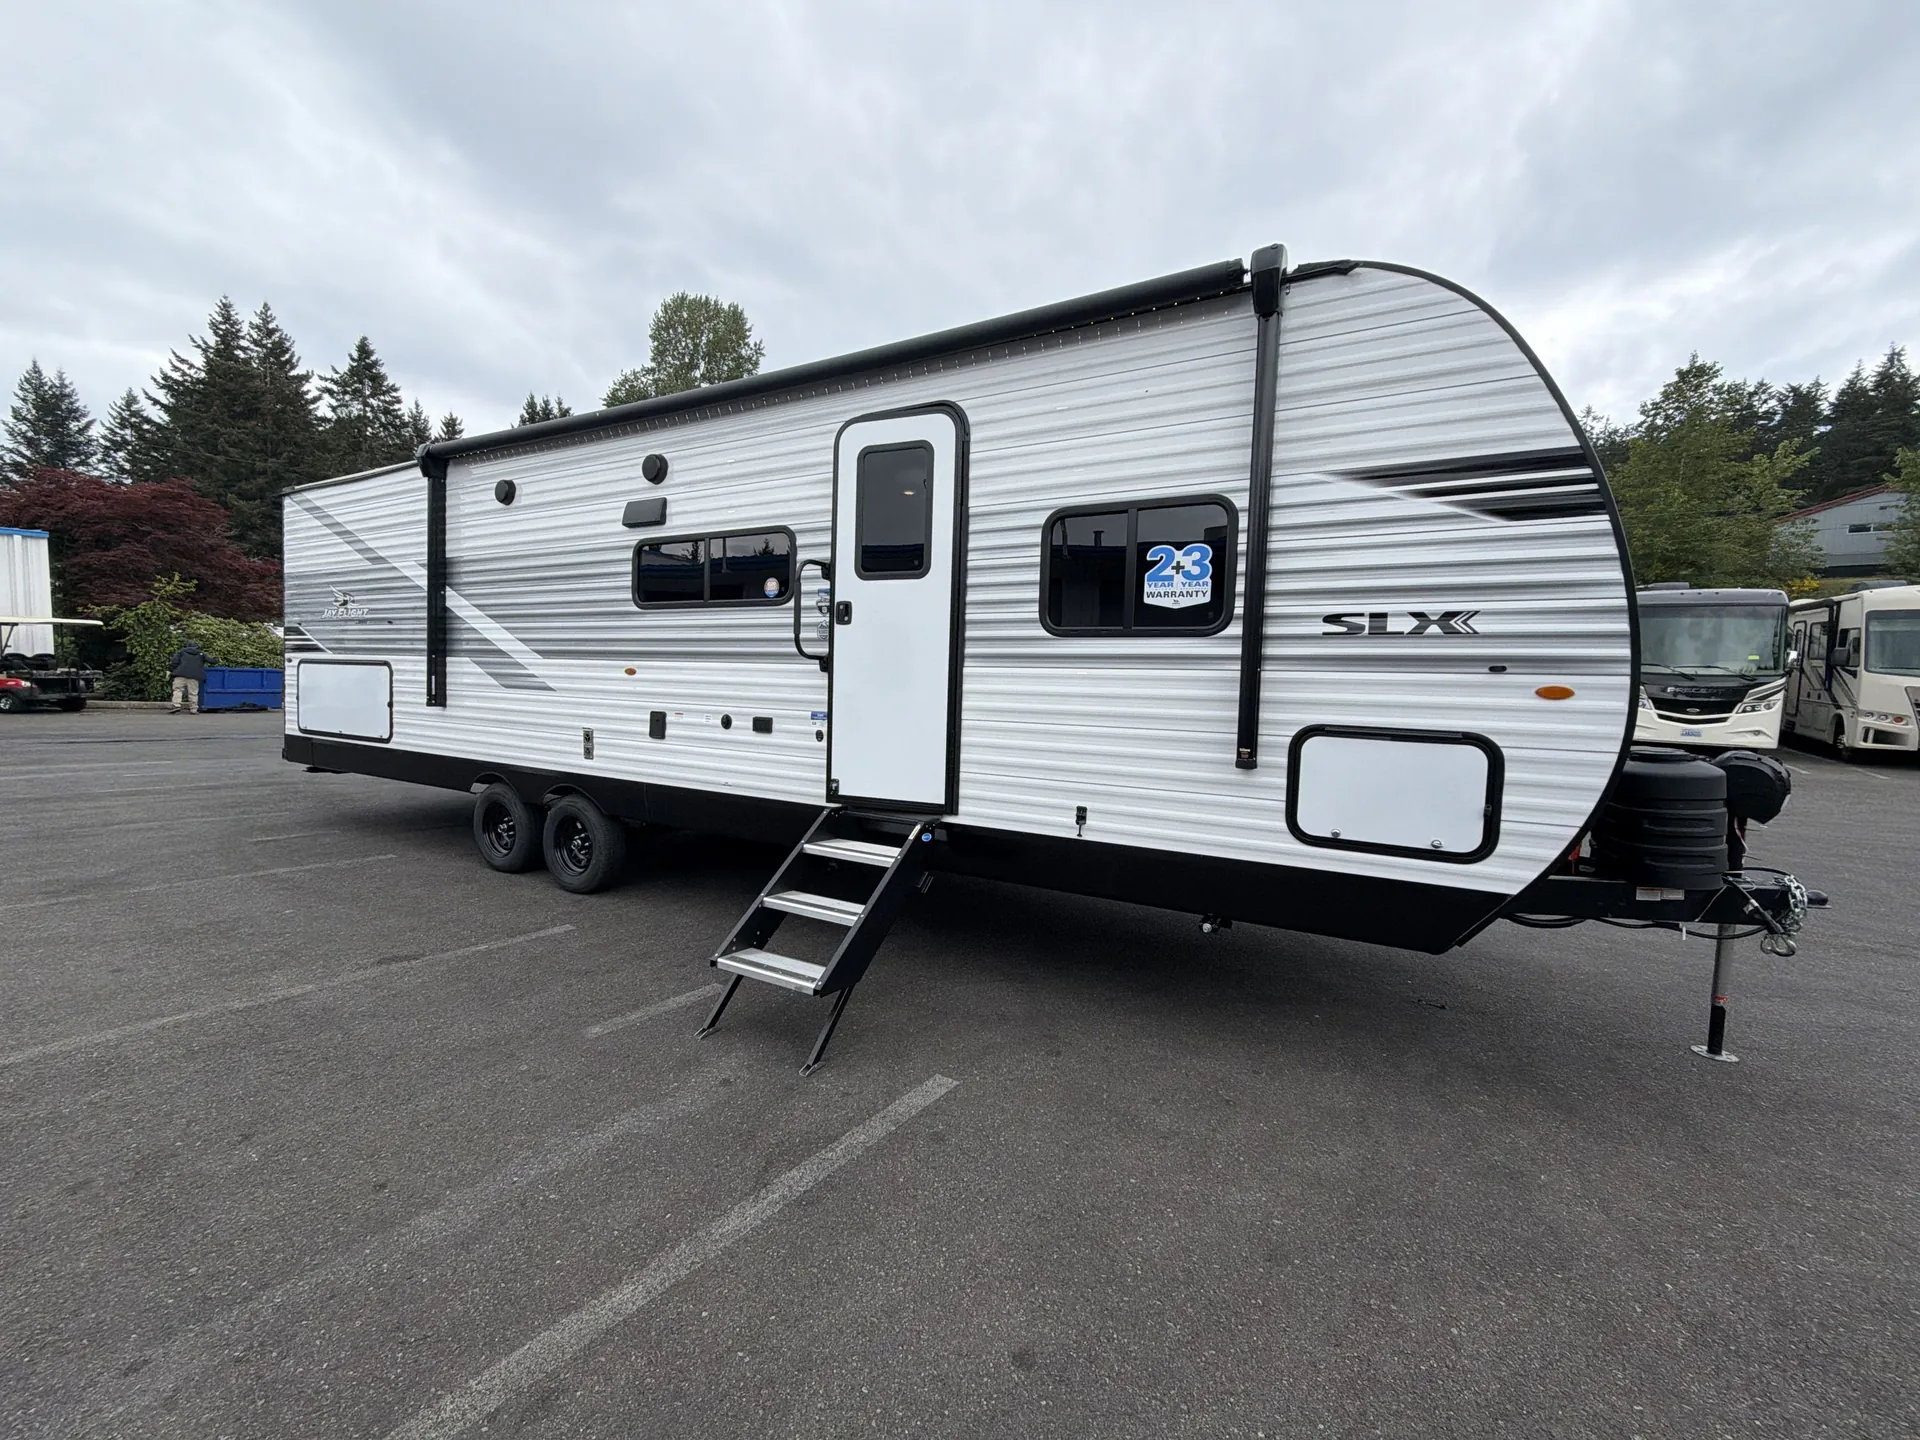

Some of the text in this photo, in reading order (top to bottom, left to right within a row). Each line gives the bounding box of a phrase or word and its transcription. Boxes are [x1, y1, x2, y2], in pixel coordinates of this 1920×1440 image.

[1181, 580, 1209, 588] YEAR
[1146, 590, 1208, 598] WARRANTY
[321, 608, 369, 619] JAY FLIGHT
[1322, 611, 1481, 635] SLX
